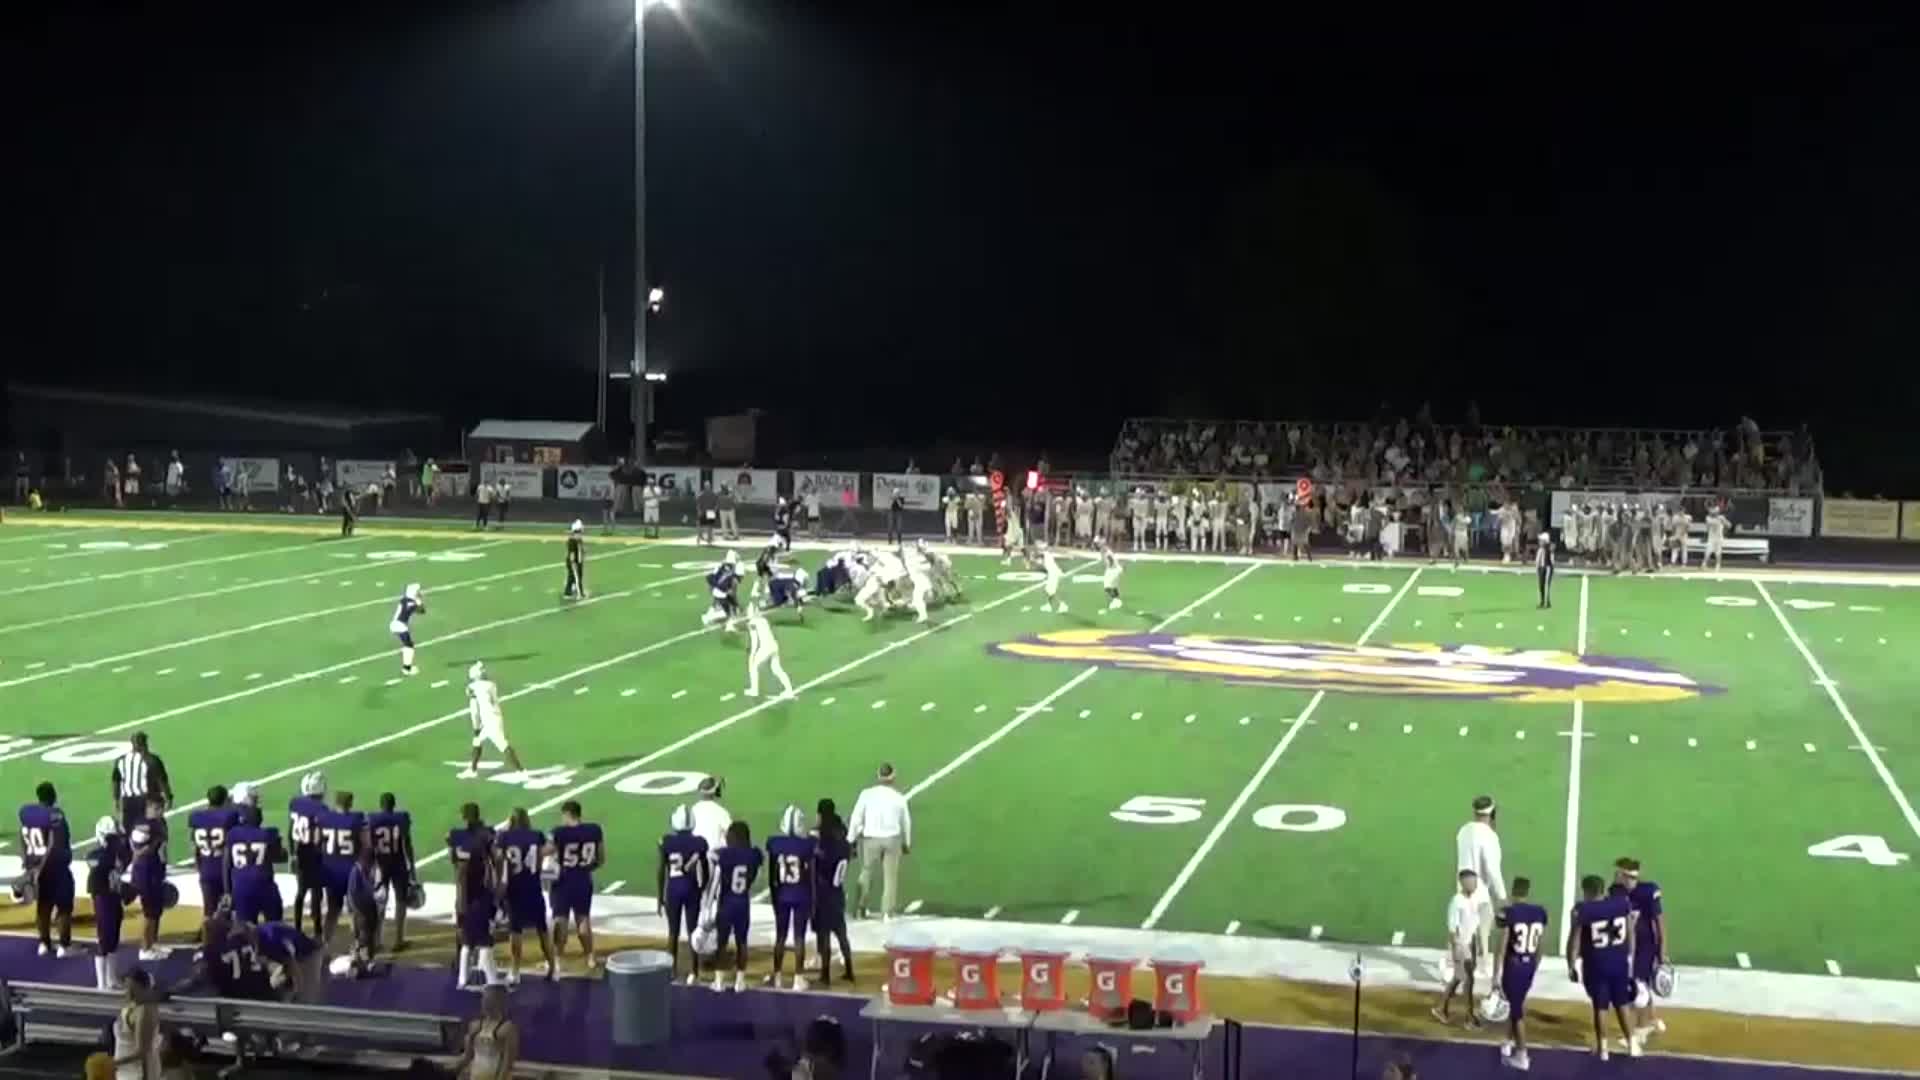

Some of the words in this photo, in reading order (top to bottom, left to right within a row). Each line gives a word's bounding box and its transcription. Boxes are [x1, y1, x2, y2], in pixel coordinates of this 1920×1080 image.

[1109, 796, 1346, 831] 50
[322, 827, 354, 855] 75
[563, 841, 596, 868] 59
[232, 842, 266, 869] 67
[777, 853, 801, 884] 13
[731, 865, 747, 894] 6
[1513, 922, 1543, 953] 30
[1591, 917, 1626, 948] 53
[894, 959, 911, 978] G
[961, 965, 979, 983] G
[1031, 963, 1048, 983] G
[1097, 971, 1114, 991] G
[1165, 974, 1183, 994] G
